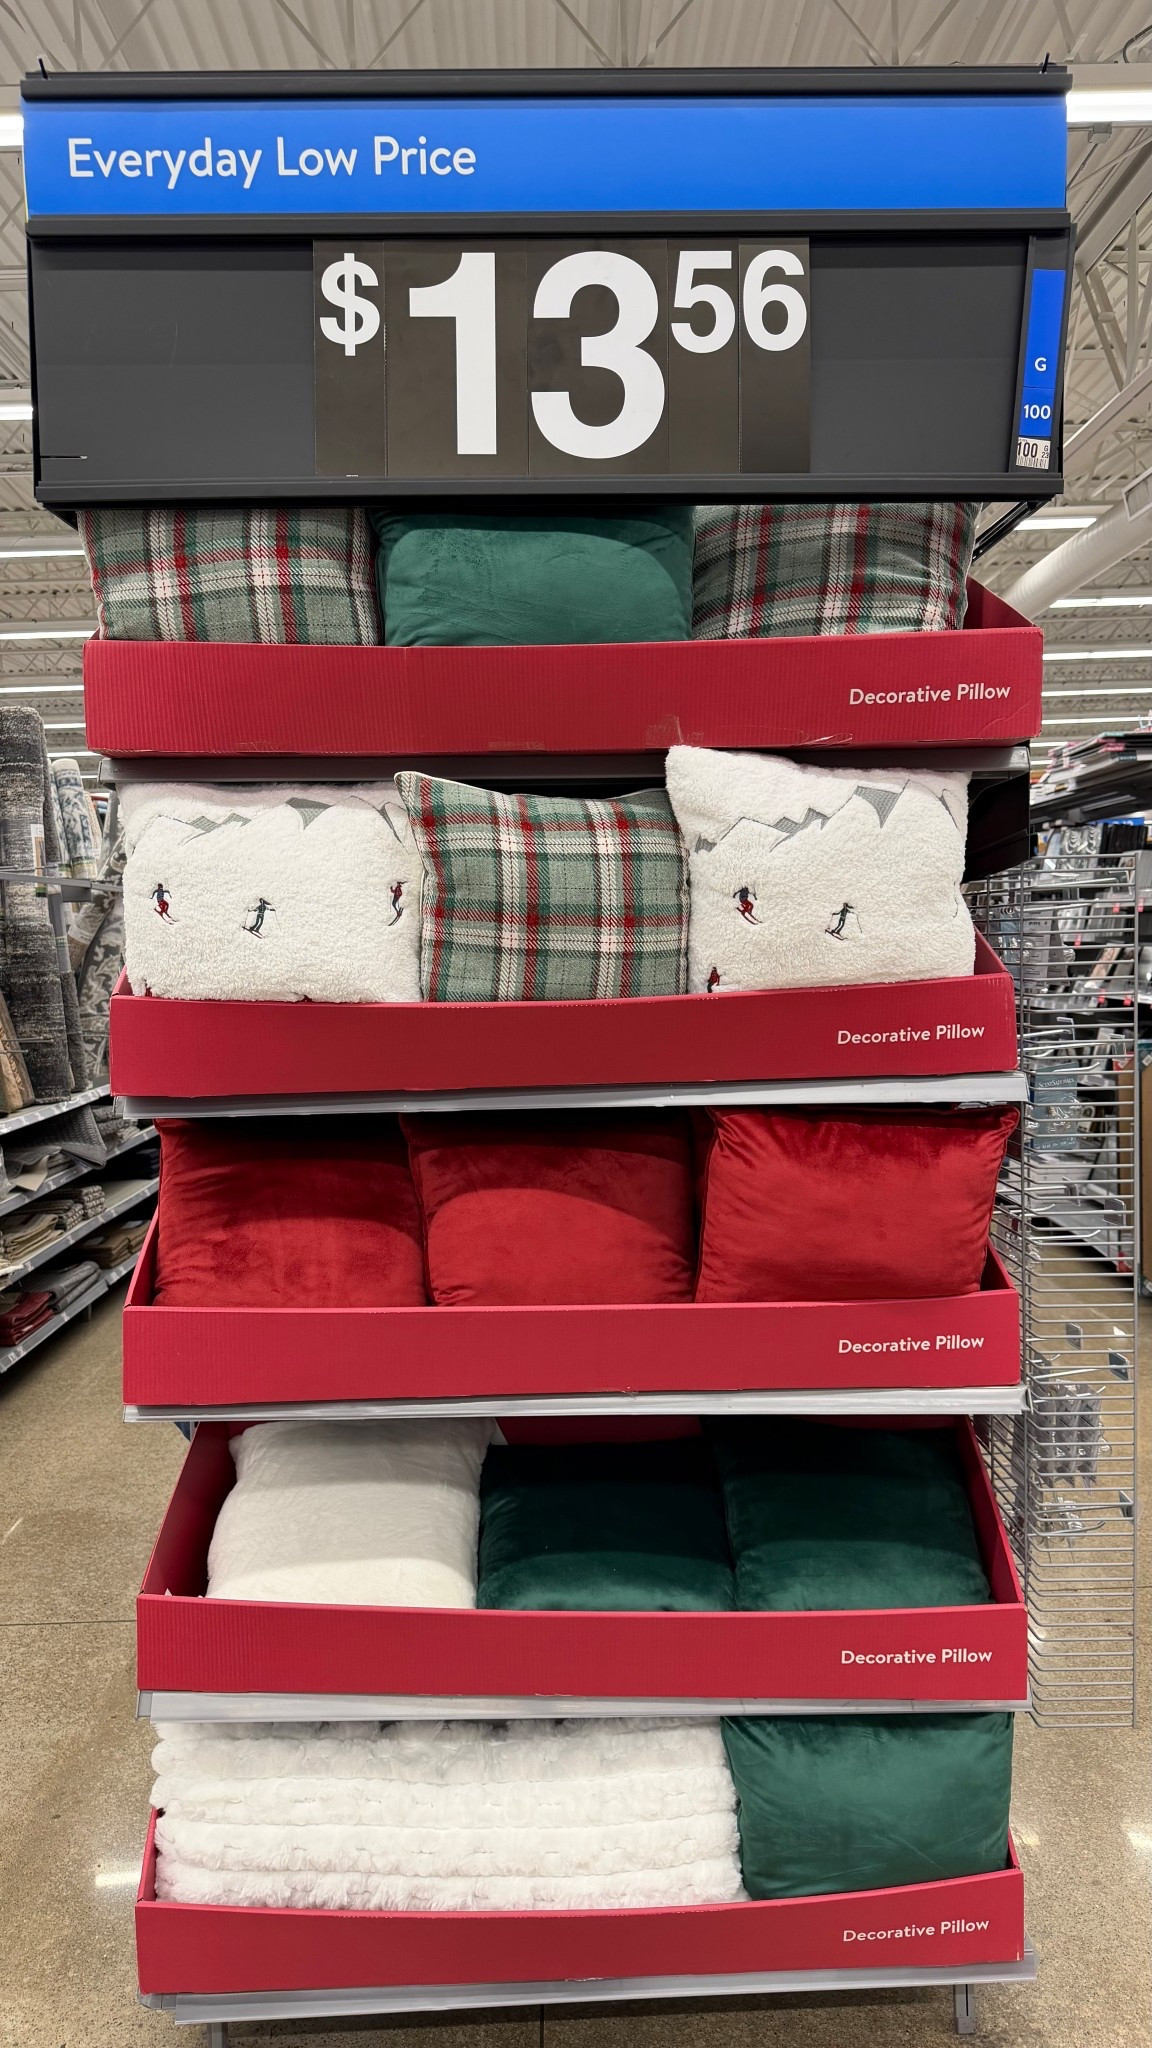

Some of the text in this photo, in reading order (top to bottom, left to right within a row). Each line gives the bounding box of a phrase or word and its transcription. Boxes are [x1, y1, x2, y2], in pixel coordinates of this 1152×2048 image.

[68, 135, 477, 190] Everyday Low Price
[1034, 357, 1047, 372] G
[1023, 404, 1051, 420] 100
[1017, 441, 1038, 458] 100
[850, 682, 1011, 705] Decorative Pillow
[837, 1023, 985, 1045] Decorative Pillow
[838, 1334, 985, 1354] Decorative Pillow
[841, 1648, 993, 1665] Decorative Pillow
[843, 1919, 990, 1942] Decorative Pillow
